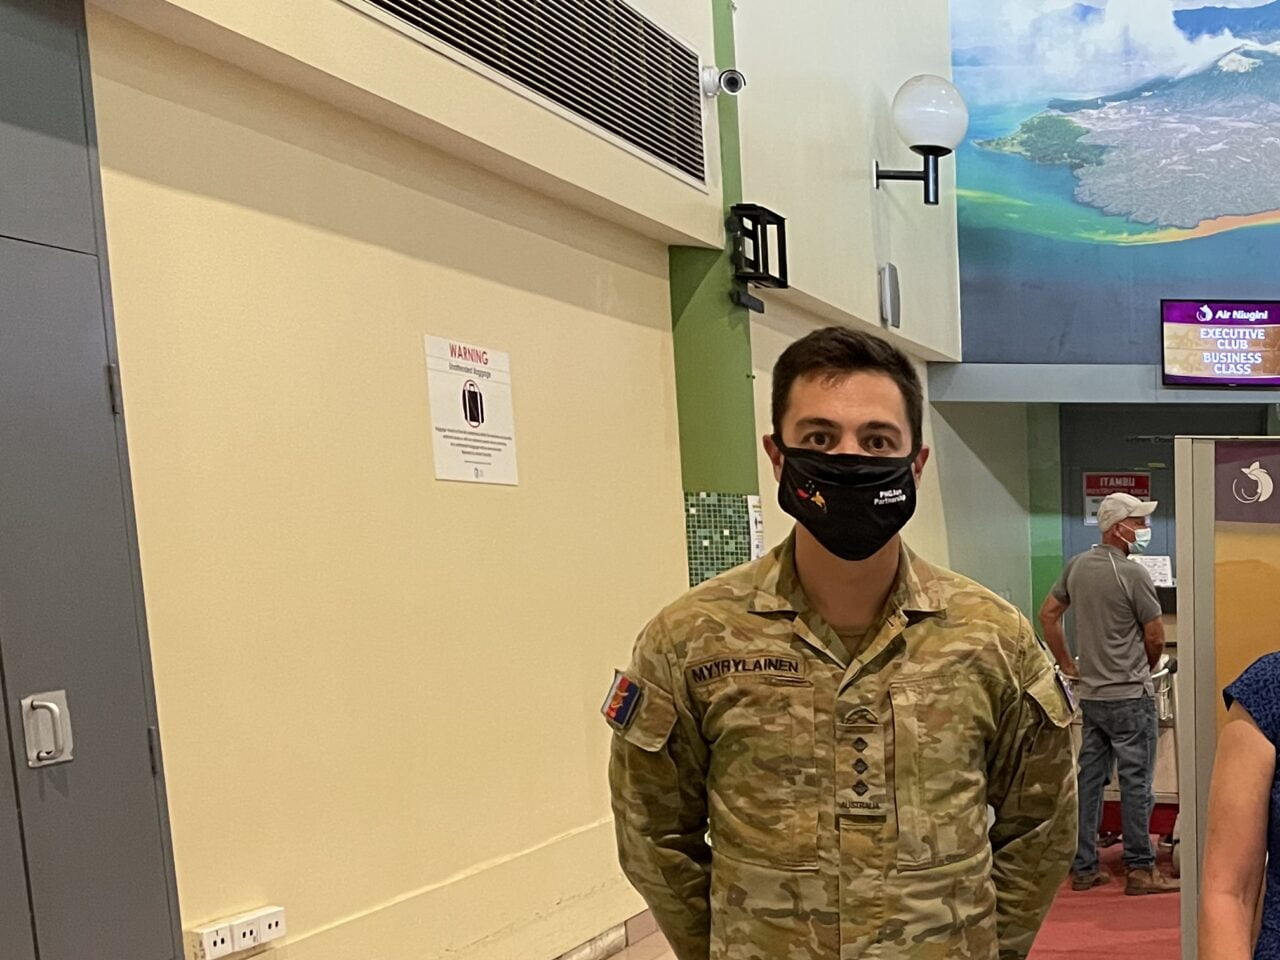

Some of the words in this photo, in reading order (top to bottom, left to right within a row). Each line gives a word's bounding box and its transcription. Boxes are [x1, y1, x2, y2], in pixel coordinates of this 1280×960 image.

[1215, 310, 1231, 320] Air
[1232, 310, 1268, 321] Niugini
[1200, 328, 1265, 340] EXECUTIVE
[1217, 340, 1248, 350] CLUB
[449, 343, 489, 366] WARNING
[1203, 352, 1262, 364] BUSINESS
[1214, 364, 1251, 375] CLASS
[1100, 476, 1135, 487] ITAMBU
[692, 658, 799, 684] MYYRYLAINEN
[838, 801, 882, 809] AUSTRALIA
